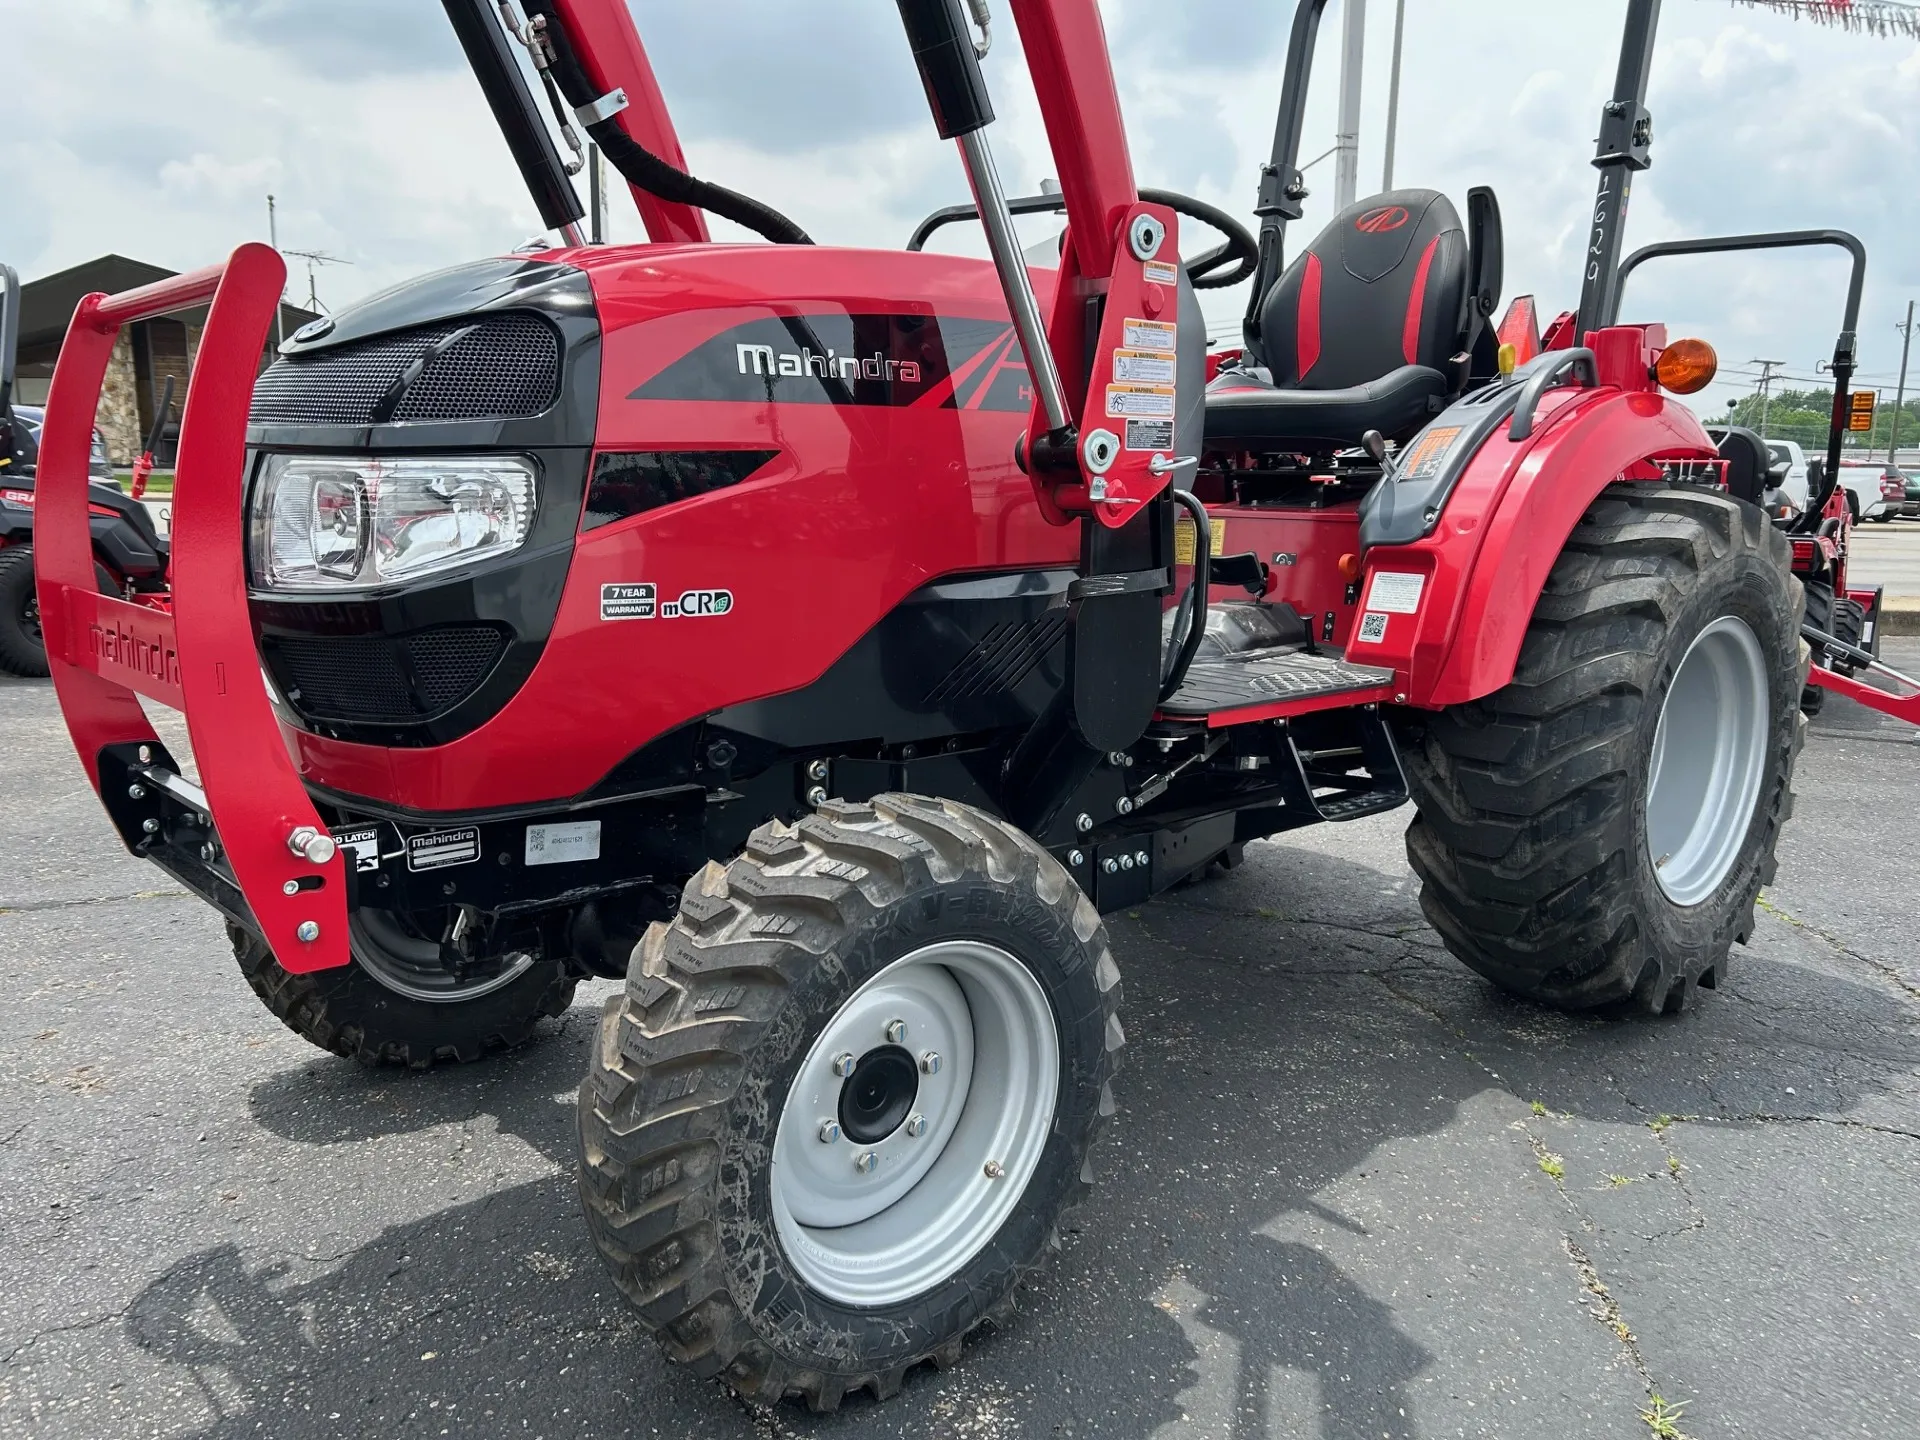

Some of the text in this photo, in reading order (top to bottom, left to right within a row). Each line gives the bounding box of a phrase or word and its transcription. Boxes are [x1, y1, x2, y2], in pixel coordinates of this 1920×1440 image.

[1587, 176, 1610, 287] 1629
[736, 343, 921, 383] Mahindra
[611, 588, 646, 598] 7 YEAR
[606, 605, 651, 614] WARRANTY
[345, 831, 375, 843] LATCH
[412, 831, 475, 848] Mahindra
